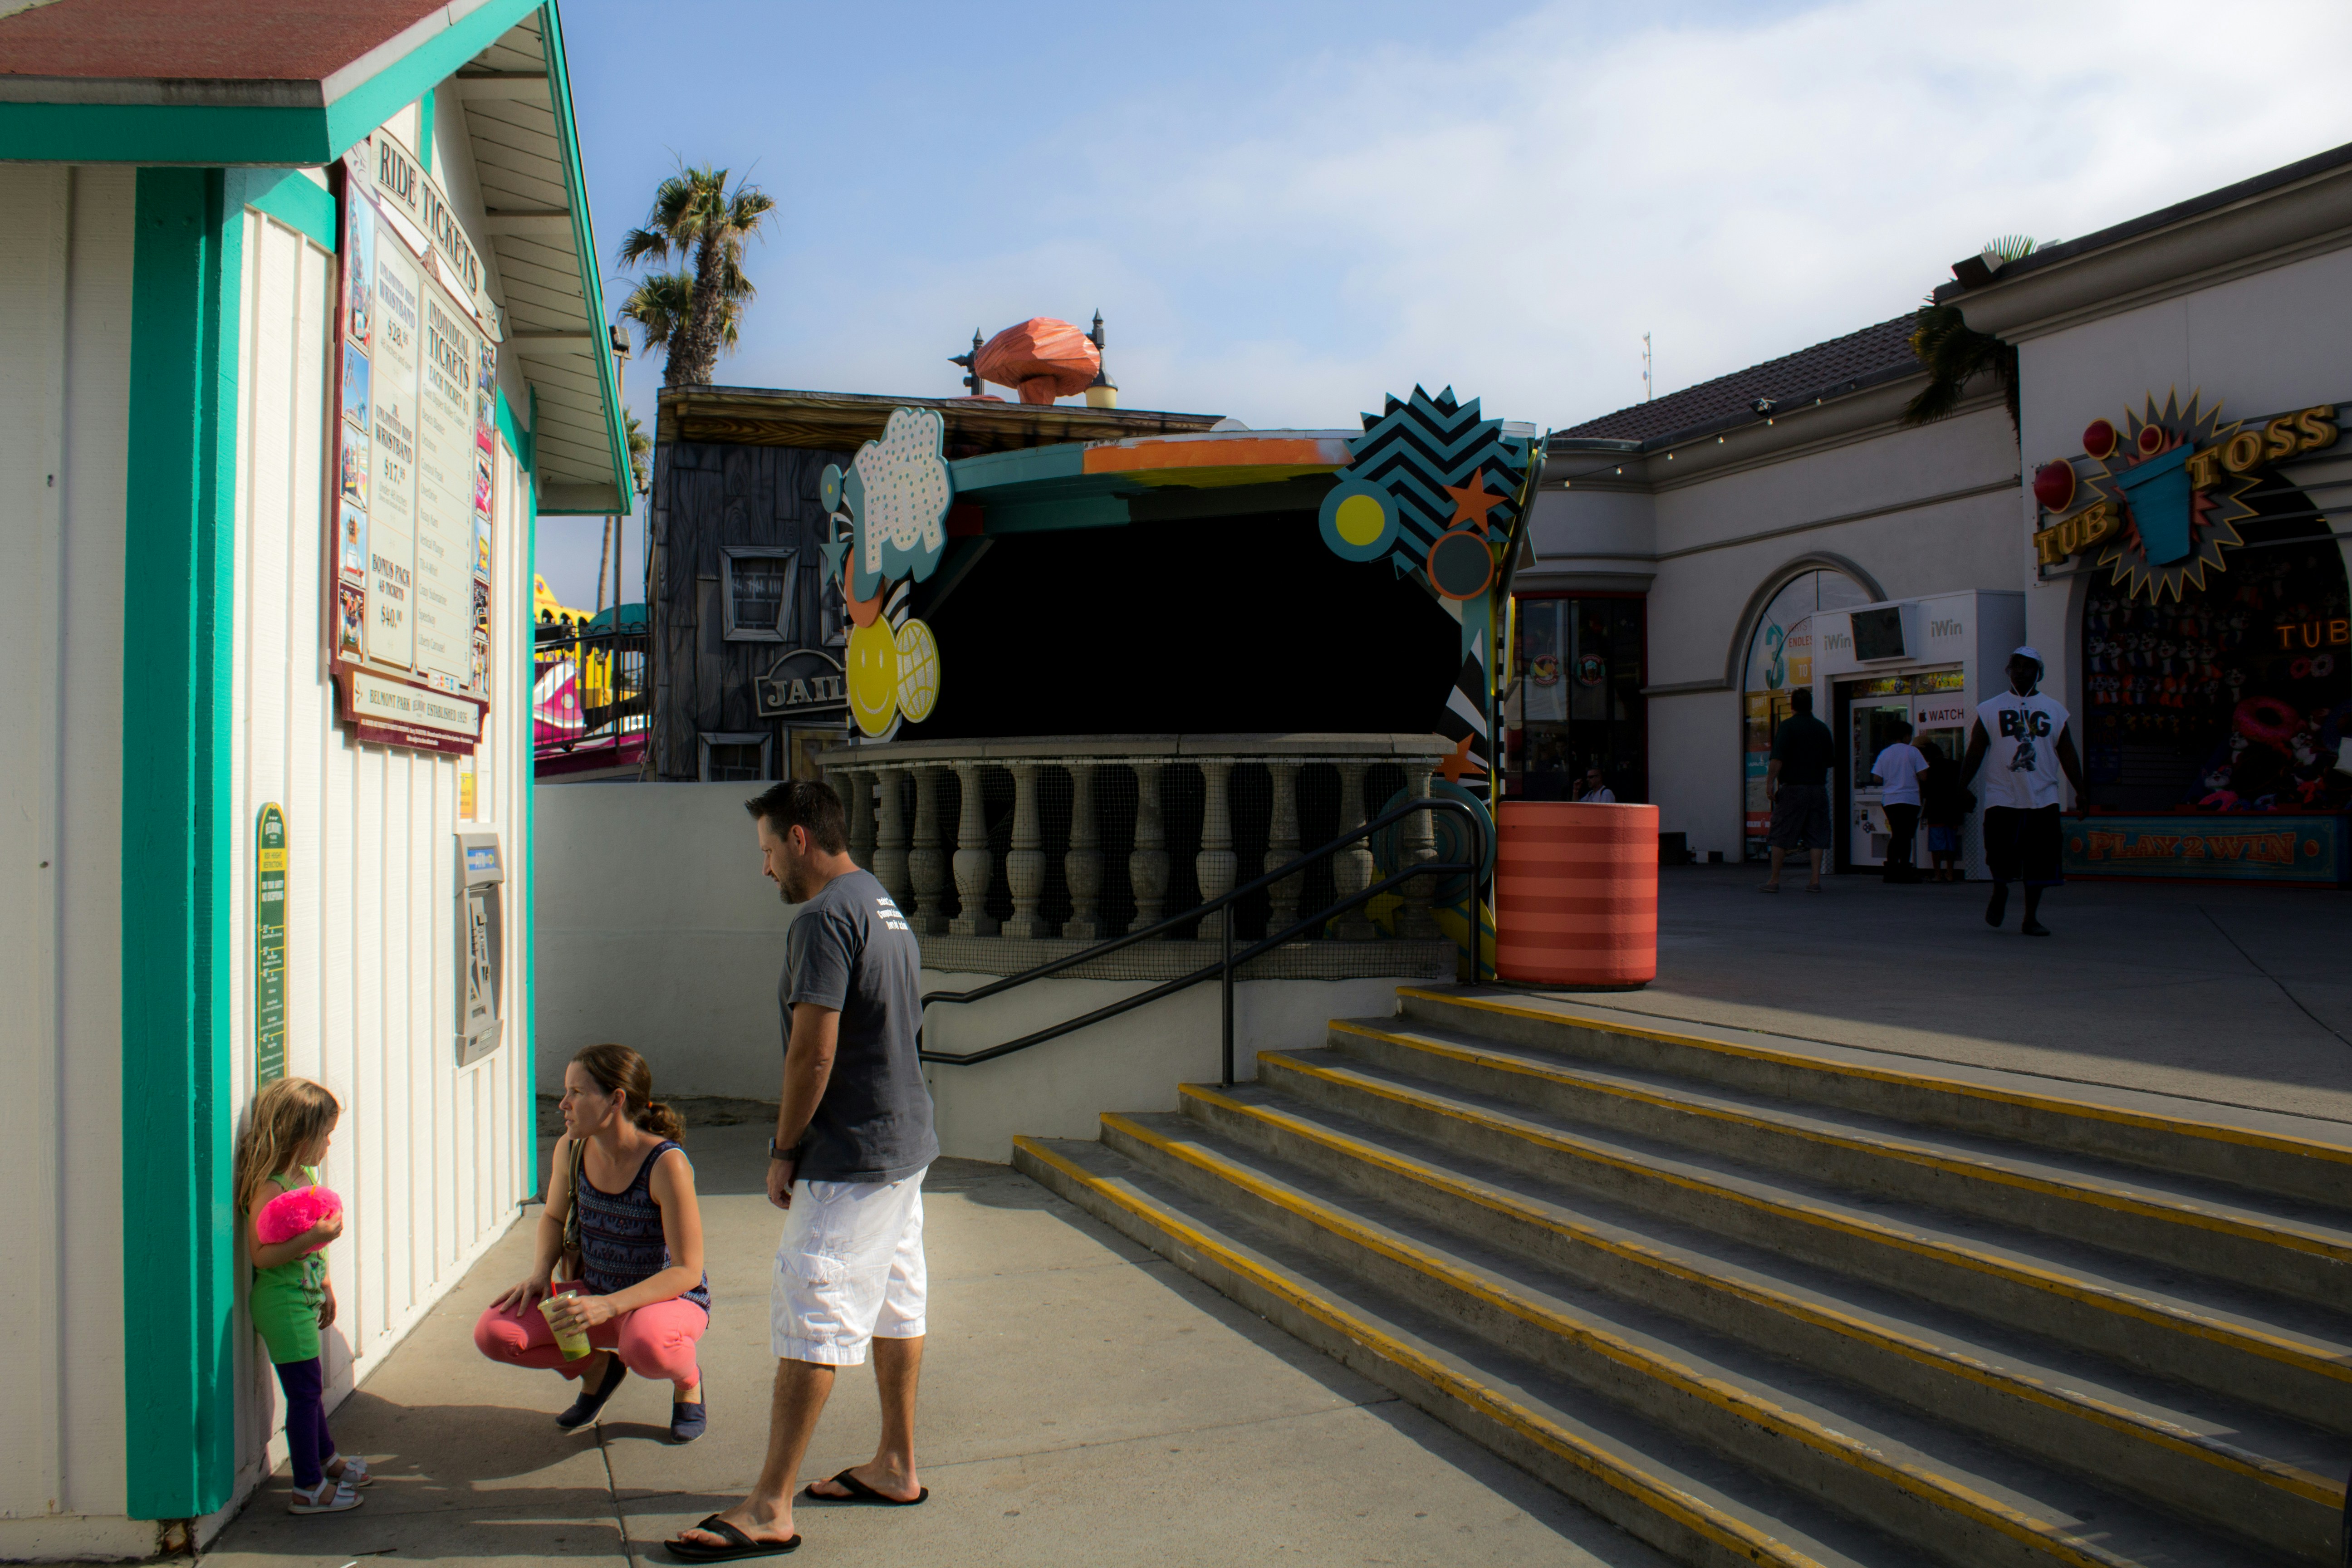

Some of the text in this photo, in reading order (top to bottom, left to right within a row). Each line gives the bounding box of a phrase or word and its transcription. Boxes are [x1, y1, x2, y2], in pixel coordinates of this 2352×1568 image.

[379, 139, 477, 295] RIDE TICKETS
[380, 261, 416, 309] UNLIMITED RIDE
[379, 279, 416, 330] WRISTBAND
[429, 299, 469, 359] INDIVIDUAL
[428, 326, 470, 392] TICKETS
[429, 364, 443, 392] EACH
[444, 378, 462, 410] TICKET
[376, 405, 401, 434] UNLIMITED
[402, 422, 413, 443] RIDE
[376, 422, 413, 465] WRISTBAND
[2186, 404, 2337, 491] TOSS
[2033, 501, 2121, 566] TUB
[372, 554, 411, 588] BONUS PACK
[386, 582, 404, 602] TICKETS
[1824, 634, 1851, 651] iWin
[1931, 619, 1962, 638] iWin
[2277, 620, 2350, 648] TUB
[1765, 624, 1785, 690] 3
[1798, 664, 1808, 677] TO
[370, 689, 397, 708] BELMONT
[397, 696, 411, 711] PARK
[427, 703, 456, 721] ESTABLISHED
[767, 675, 847, 707] JAIL
[1929, 708, 1964, 721] WATCH
[1999, 709, 2052, 738] BIG
[2087, 831, 2296, 865] PLAY 2 WIN
